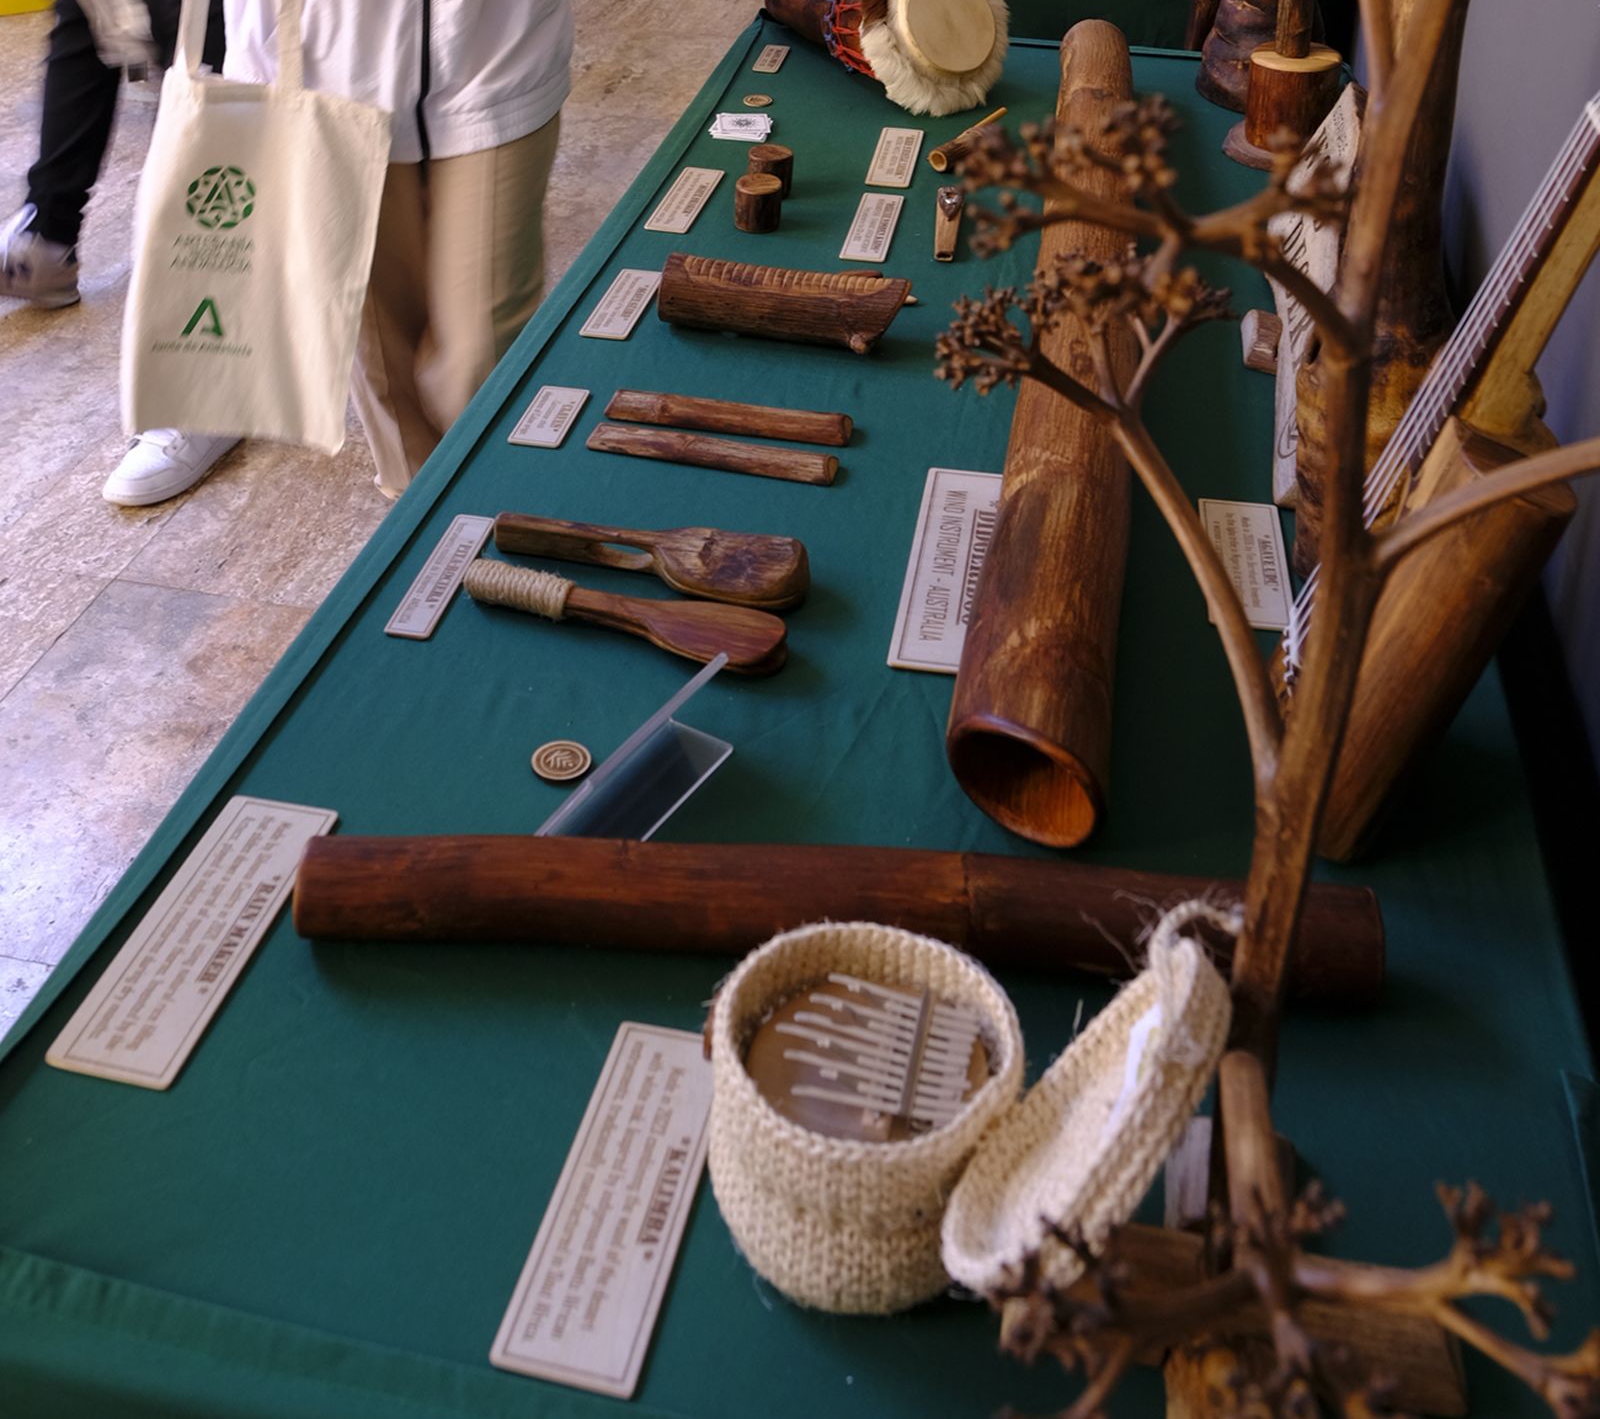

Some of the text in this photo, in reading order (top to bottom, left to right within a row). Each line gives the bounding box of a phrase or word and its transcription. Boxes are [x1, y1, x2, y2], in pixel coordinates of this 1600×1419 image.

[943, 490, 967, 513] WIND
[932, 515, 962, 575] INSTRUMENT
[919, 585, 950, 640] AUSTRALIA
[199, 883, 276, 982] RAIN MAKER
[640, 1149, 686, 1244] KALIMBA
